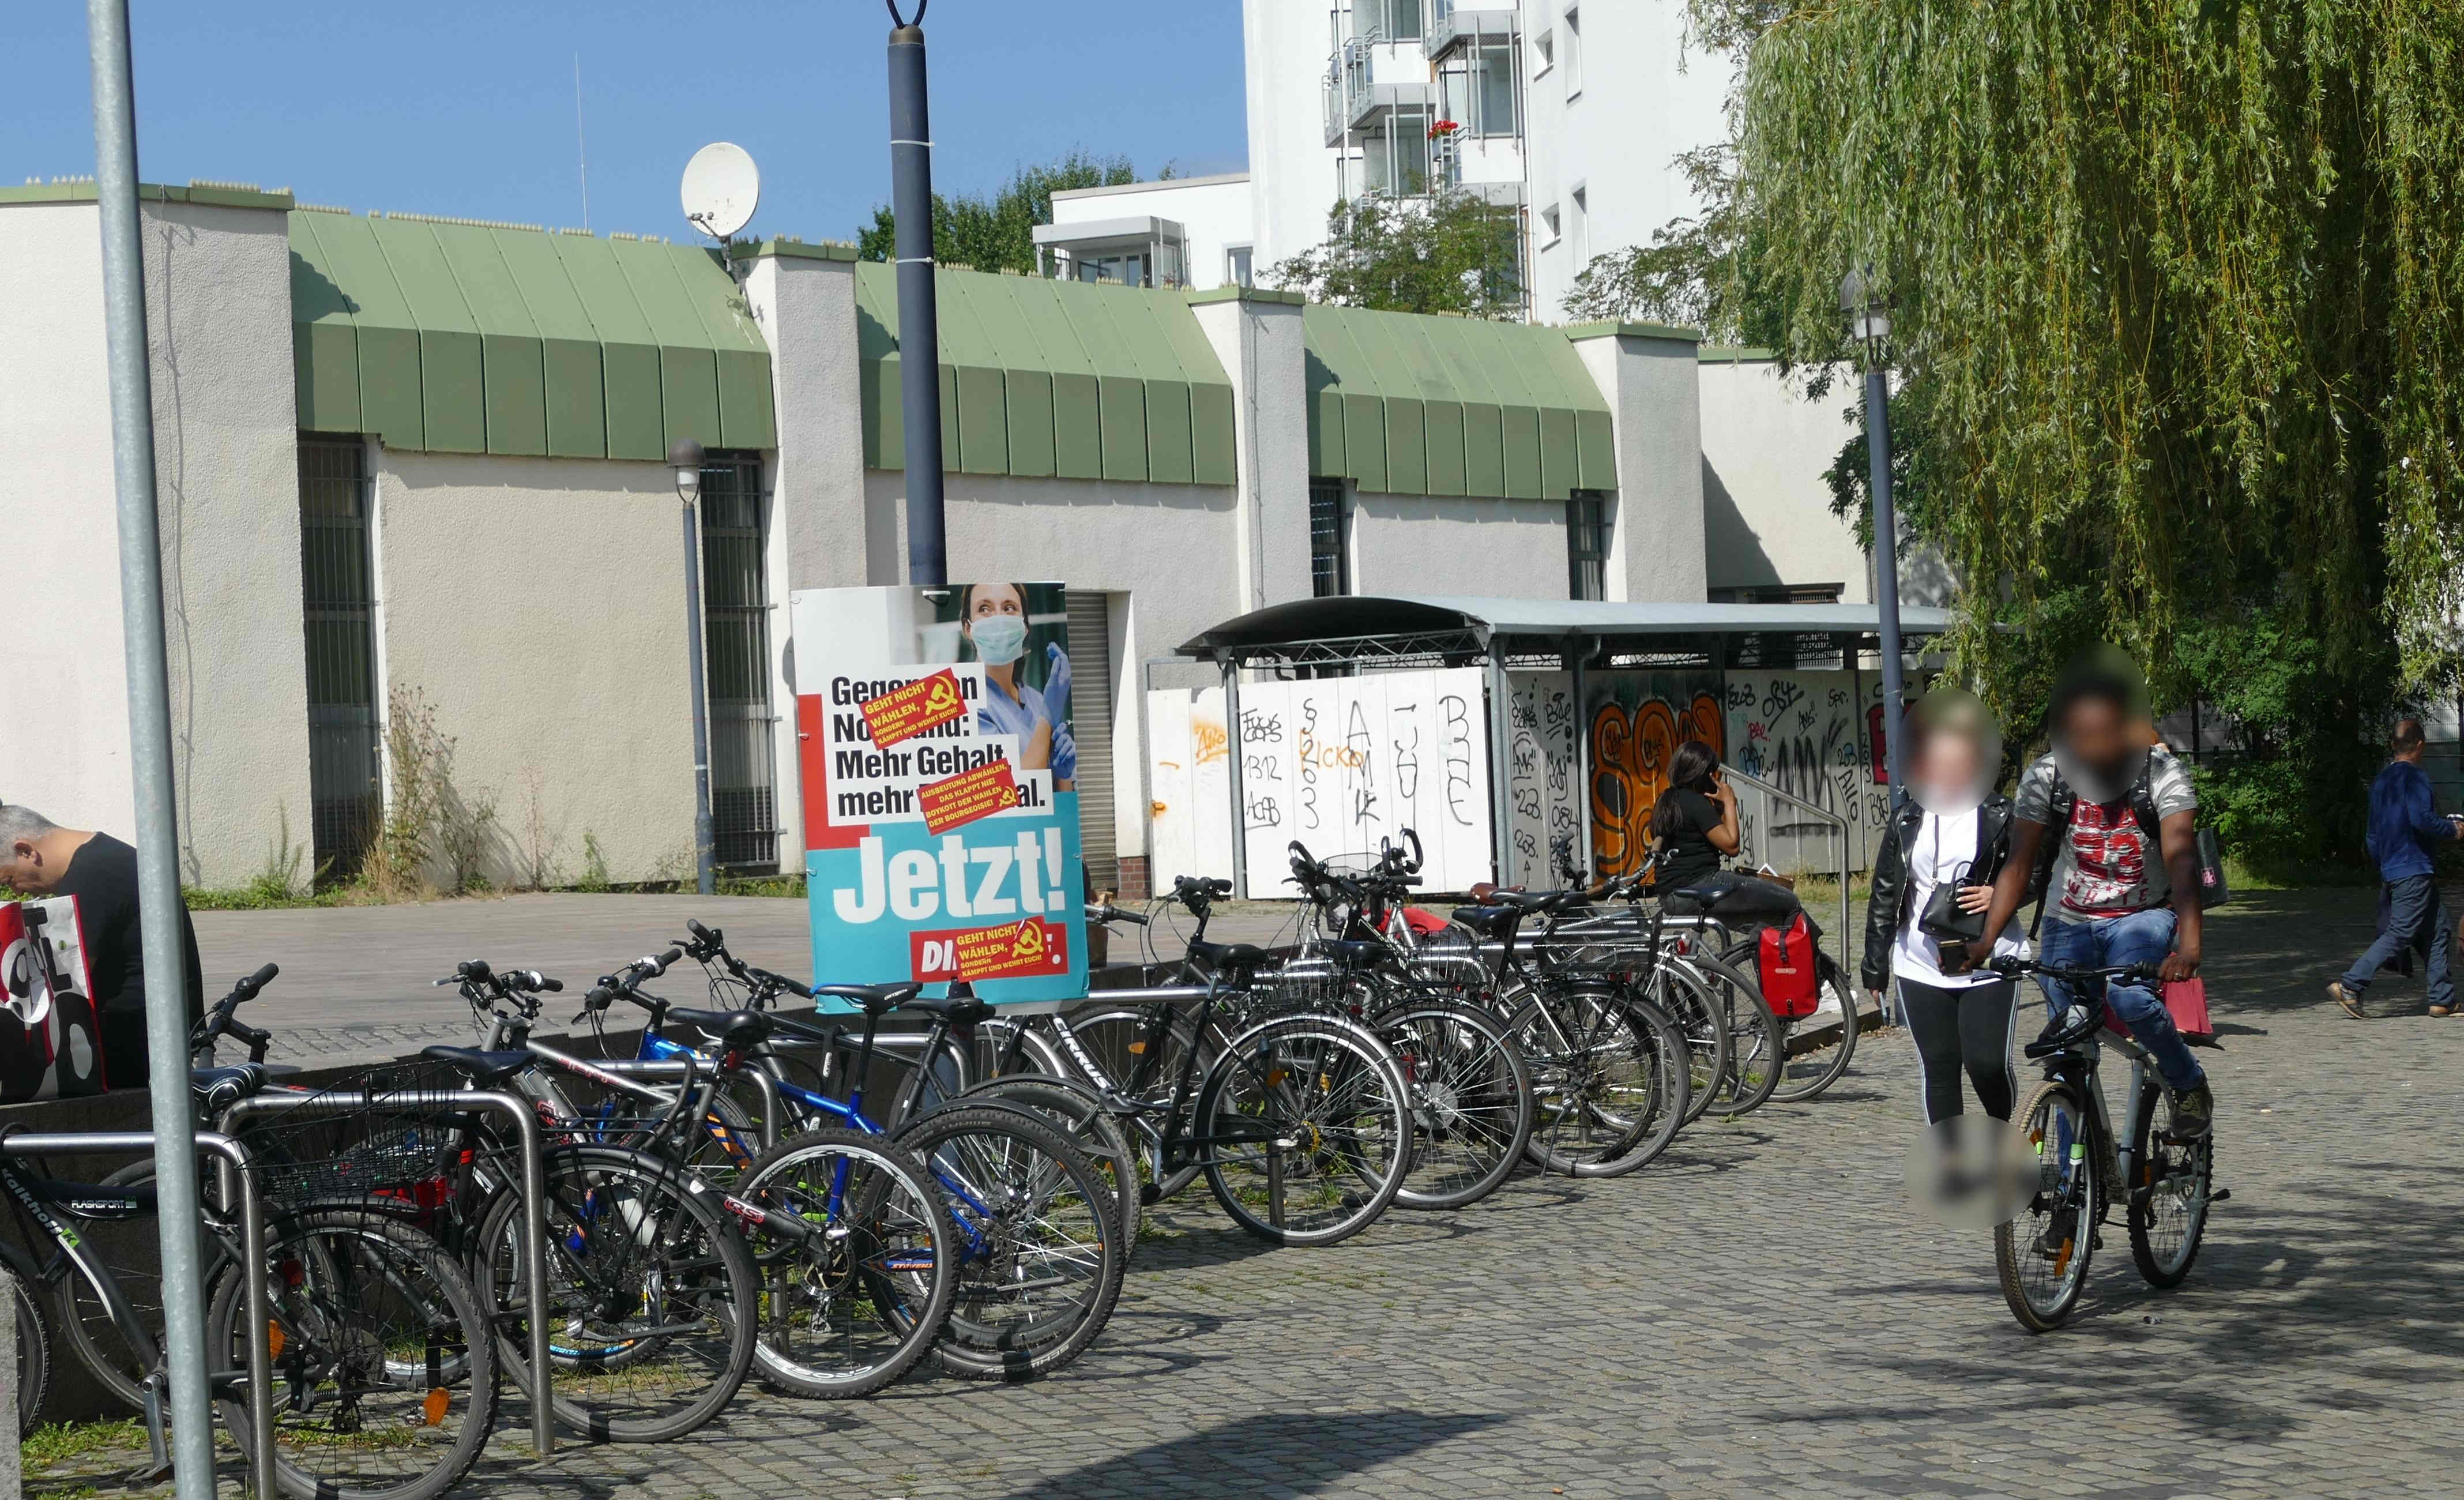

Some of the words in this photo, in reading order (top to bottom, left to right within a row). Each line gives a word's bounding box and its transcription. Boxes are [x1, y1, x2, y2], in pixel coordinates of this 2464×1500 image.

[865, 696, 893, 715] GEHT
[894, 682, 926, 702] NICHT
[870, 702, 920, 728] WÄHLEN,
[874, 720, 905, 736] SONDERN
[878, 730, 903, 745] KÄMPFT
[904, 724, 917, 734] UND
[917, 716, 939, 728] WEHRT
[939, 706, 958, 719] EUCH!
[836, 748, 912, 779] Mehr
[917, 743, 1011, 775] Gehalt
[838, 785, 913, 817] mehr
[921, 778, 966, 799] AUSBEUTUNG
[939, 792, 953, 803] DAS
[955, 784, 980, 798] KLAPPT
[981, 777, 995, 788] NIE!
[926, 804, 956, 818] BOYKOTT
[957, 796, 972, 807] DER
[929, 817, 944, 828] DER
[945, 799, 994, 822] BOURGEOISIE!
[833, 827, 1066, 923] Jetzt!
[957, 932, 984, 945] GEHT
[987, 925, 1017, 940] NICHT
[921, 939, 957, 972] DI
[958, 943, 1008, 960] WÄHLEN,
[961, 958, 992, 969] SONDERN
[989, 964, 1002, 972] UND
[1003, 959, 1024, 969] WEHRT
[1053, 1017, 1112, 1089] CIRRUS
[72, 1200, 124, 1209] FLASHSPORT
